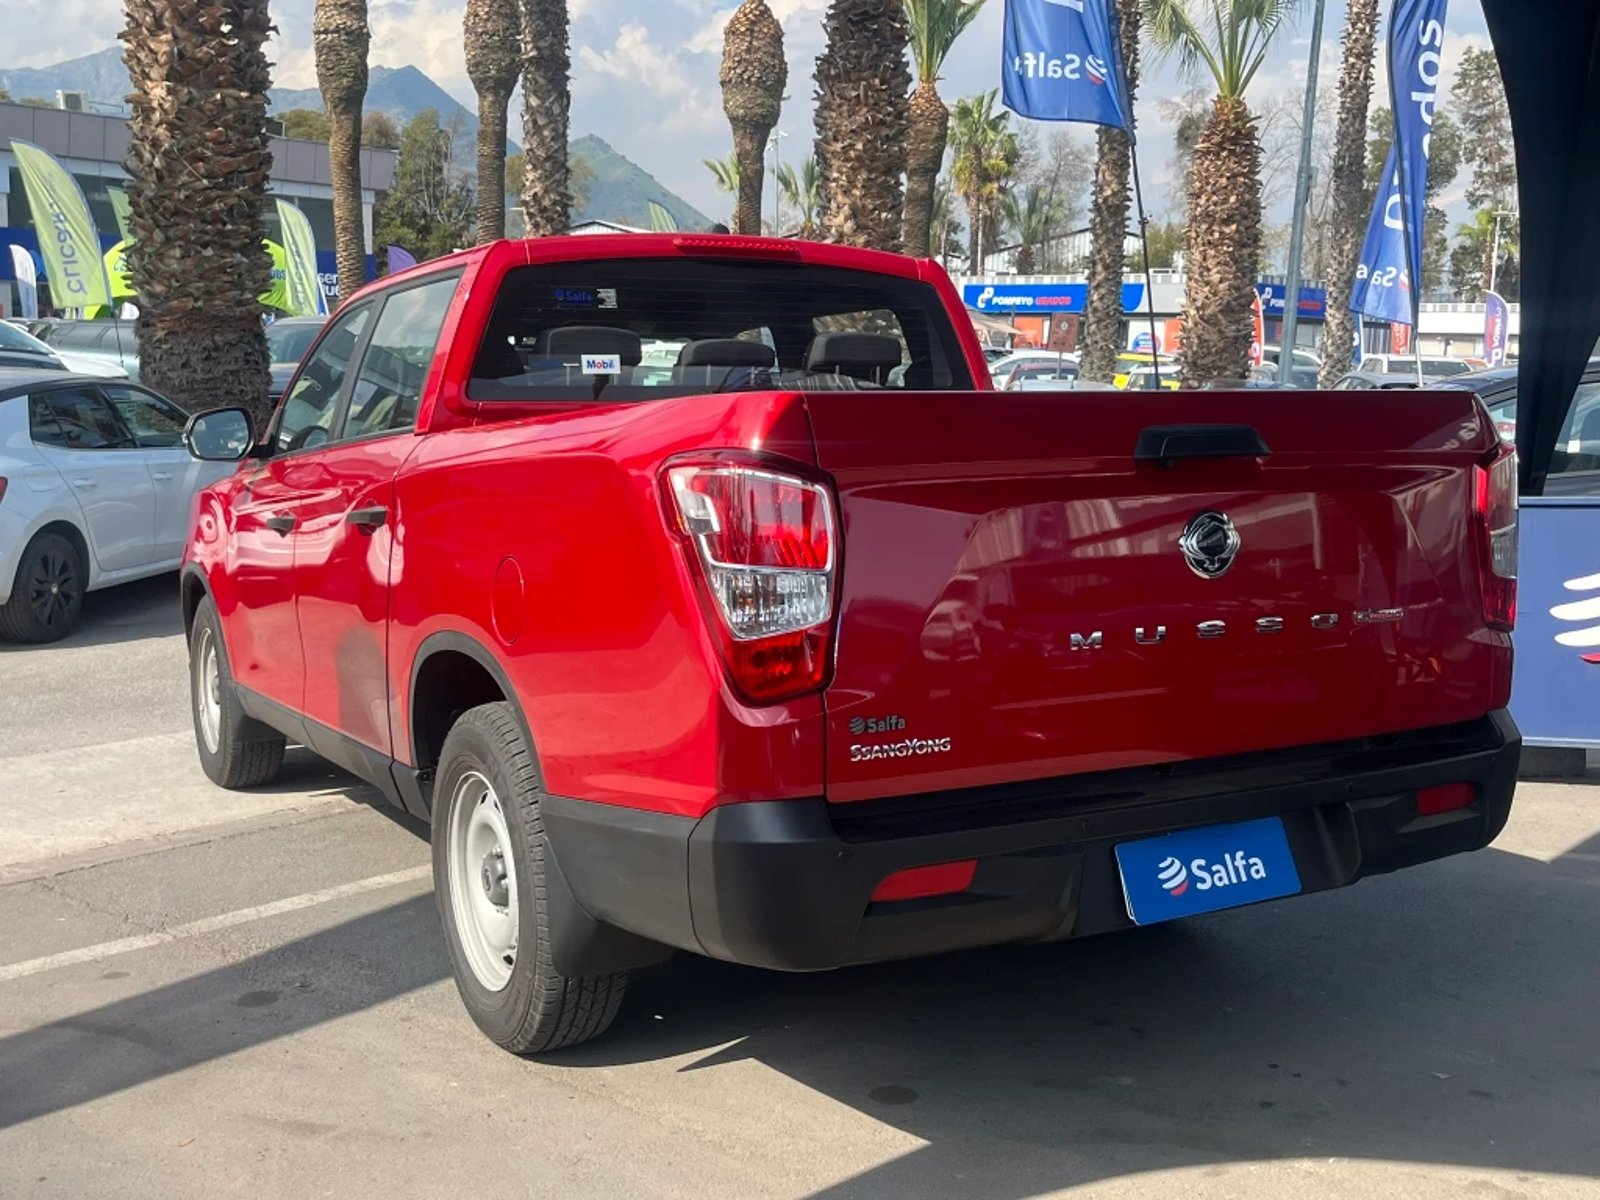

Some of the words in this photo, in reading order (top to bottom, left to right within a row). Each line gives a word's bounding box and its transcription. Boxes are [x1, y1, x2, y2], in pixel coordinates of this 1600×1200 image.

[586, 360, 615, 369] Mobil
[1070, 612, 1339, 651] MUSSO
[866, 715, 906, 733] Salfa
[1190, 850, 1266, 890] Salfa
